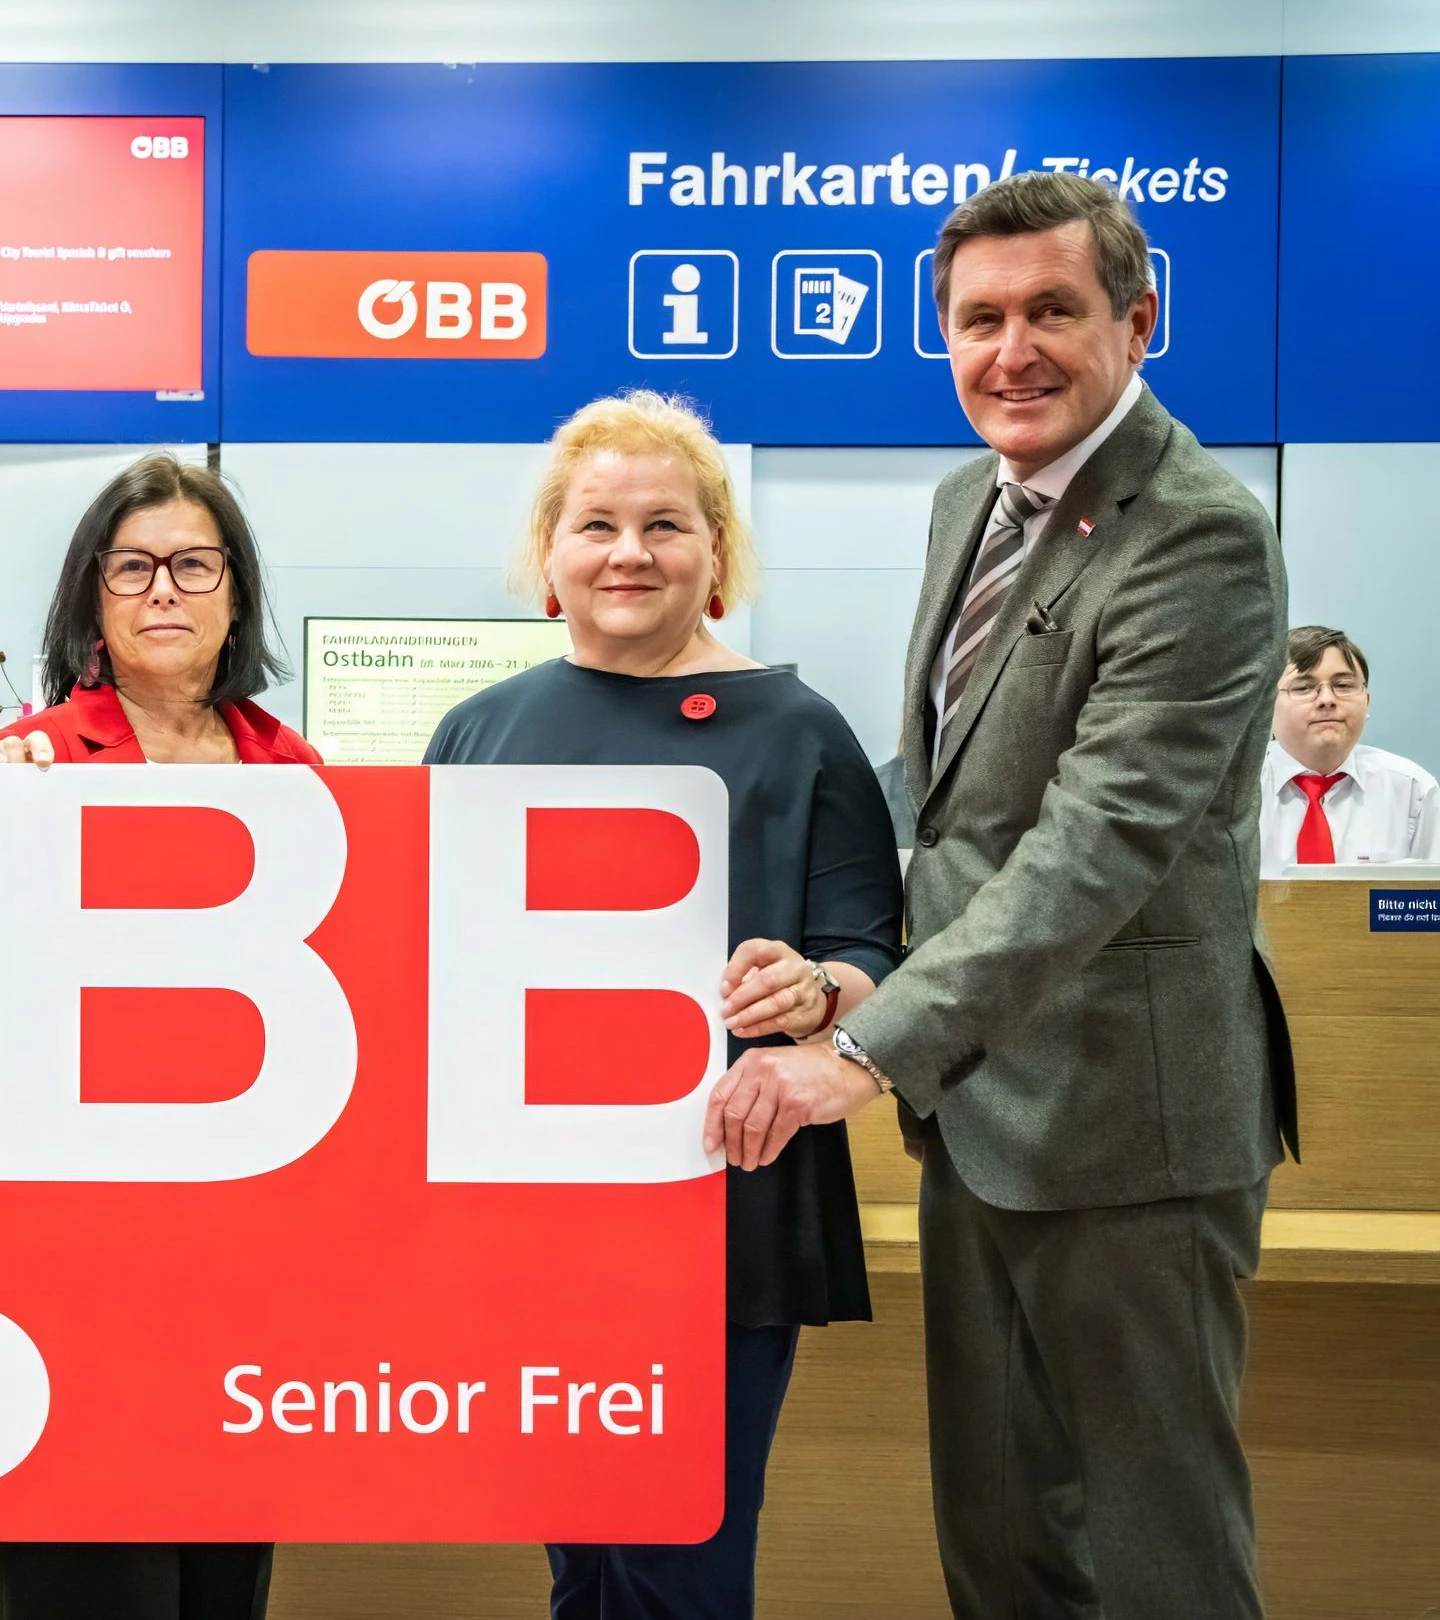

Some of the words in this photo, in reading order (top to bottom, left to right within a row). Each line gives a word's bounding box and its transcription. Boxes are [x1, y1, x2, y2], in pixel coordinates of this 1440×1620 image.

[629, 149, 1017, 206] Fahrkarten/
[357, 278, 528, 340] ÖBB
[323, 649, 413, 668] Ostbahn
[1378, 899, 1405, 910] Bitte
[1408, 899, 1437, 910] nicht
[221, 1362, 486, 1435] Senior
[519, 1363, 665, 1435] Frei
